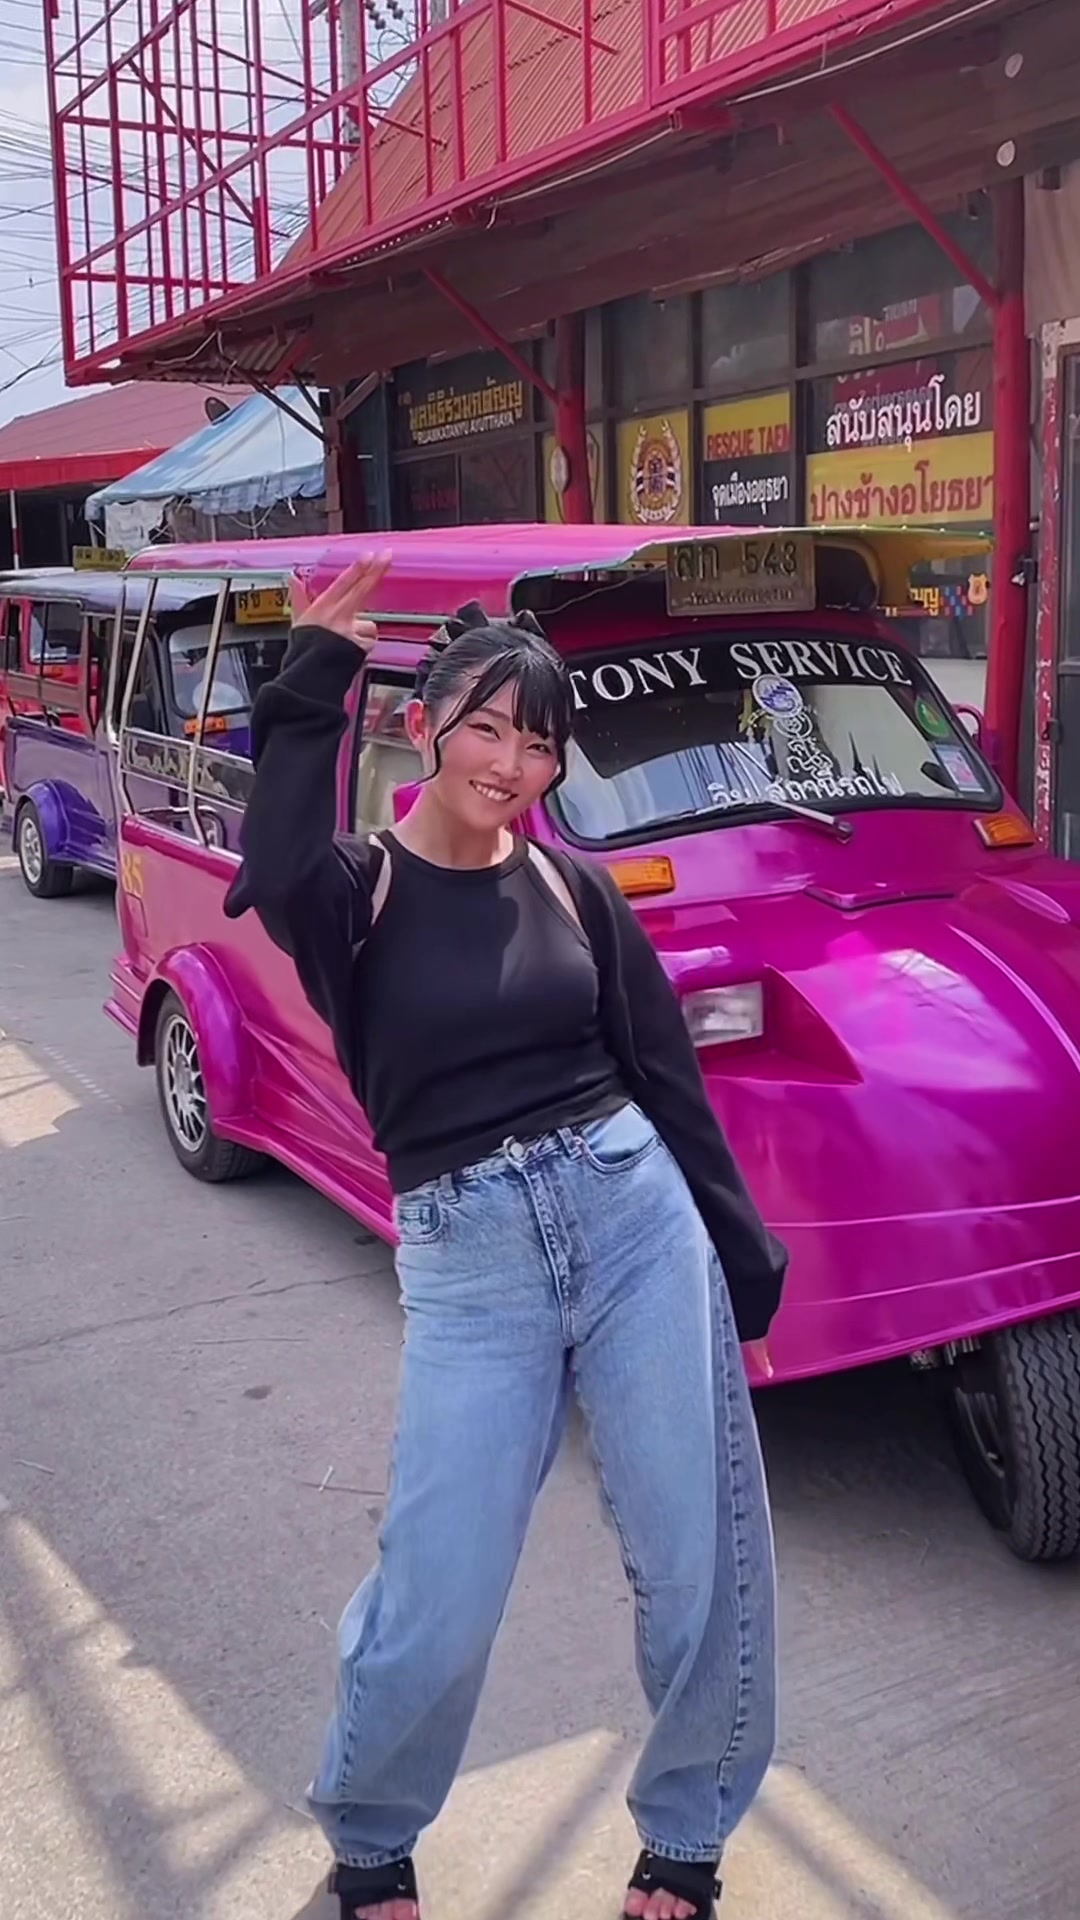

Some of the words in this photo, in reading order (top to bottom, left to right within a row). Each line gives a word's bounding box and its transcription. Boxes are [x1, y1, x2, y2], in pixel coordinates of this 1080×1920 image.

[826, 374, 981, 453] สนับสนุนโดย
[707, 428, 754, 460] RESCUE
[711, 471, 789, 521] จุดเมืองอยุธยา
[741, 540, 797, 577] 543
[568, 649, 707, 710] TONY
[730, 640, 913, 686] SERVICE
[765, 766, 906, 802] สถานีรถไฟ
